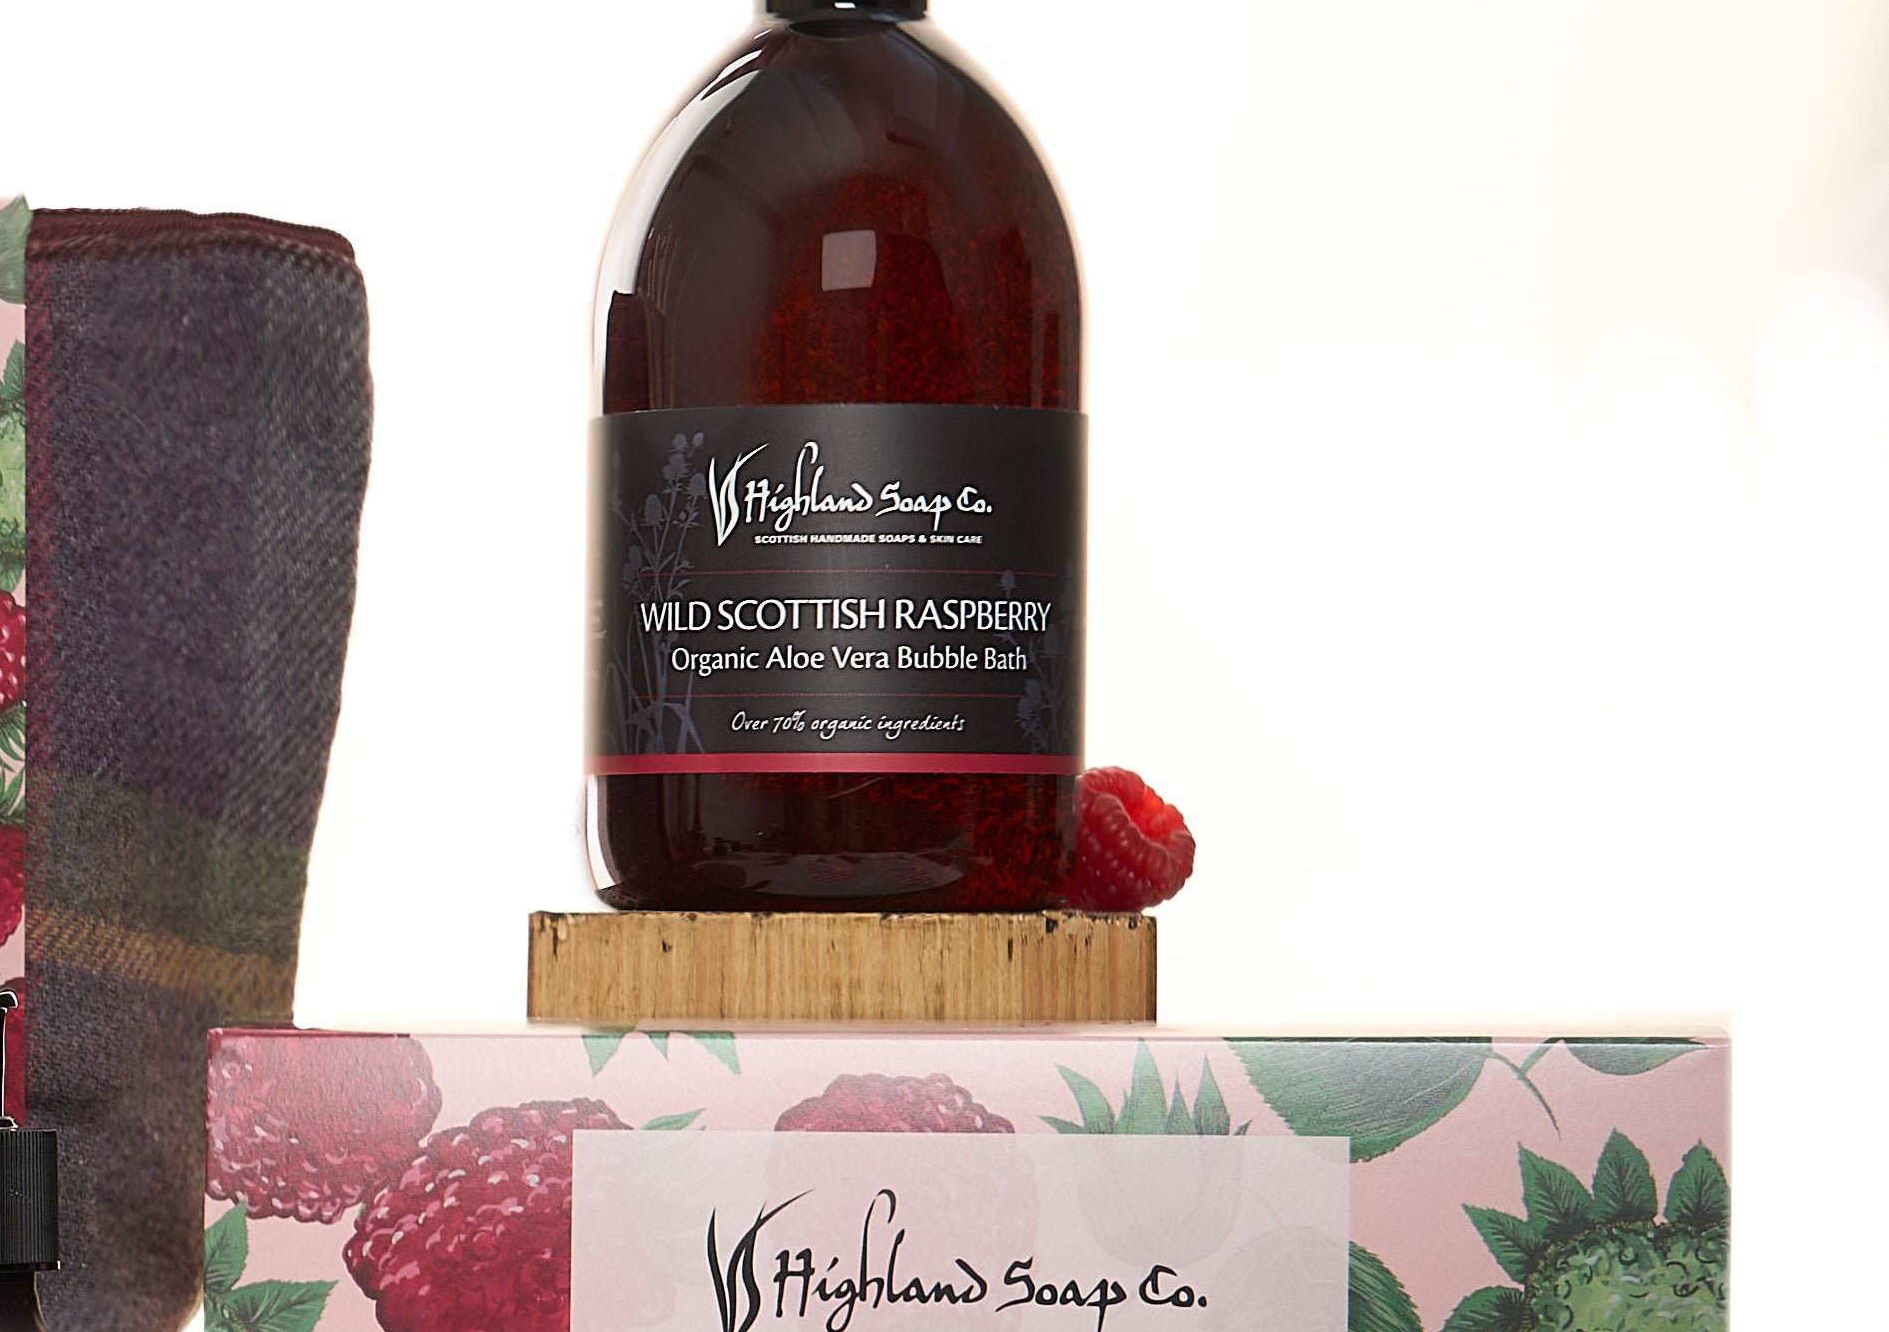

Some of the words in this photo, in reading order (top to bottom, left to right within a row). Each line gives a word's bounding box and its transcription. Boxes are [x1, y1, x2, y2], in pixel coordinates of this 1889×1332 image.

[671, 646, 760, 677] Organic
[765, 644, 825, 669] Aloe
[831, 645, 890, 669] Vera
[897, 644, 978, 670] Bubble
[984, 646, 1027, 670] Bath
[731, 711, 769, 731] Over
[772, 709, 806, 733] 70%
[810, 715, 872, 740] organic
[877, 714, 965, 740] ingredients
